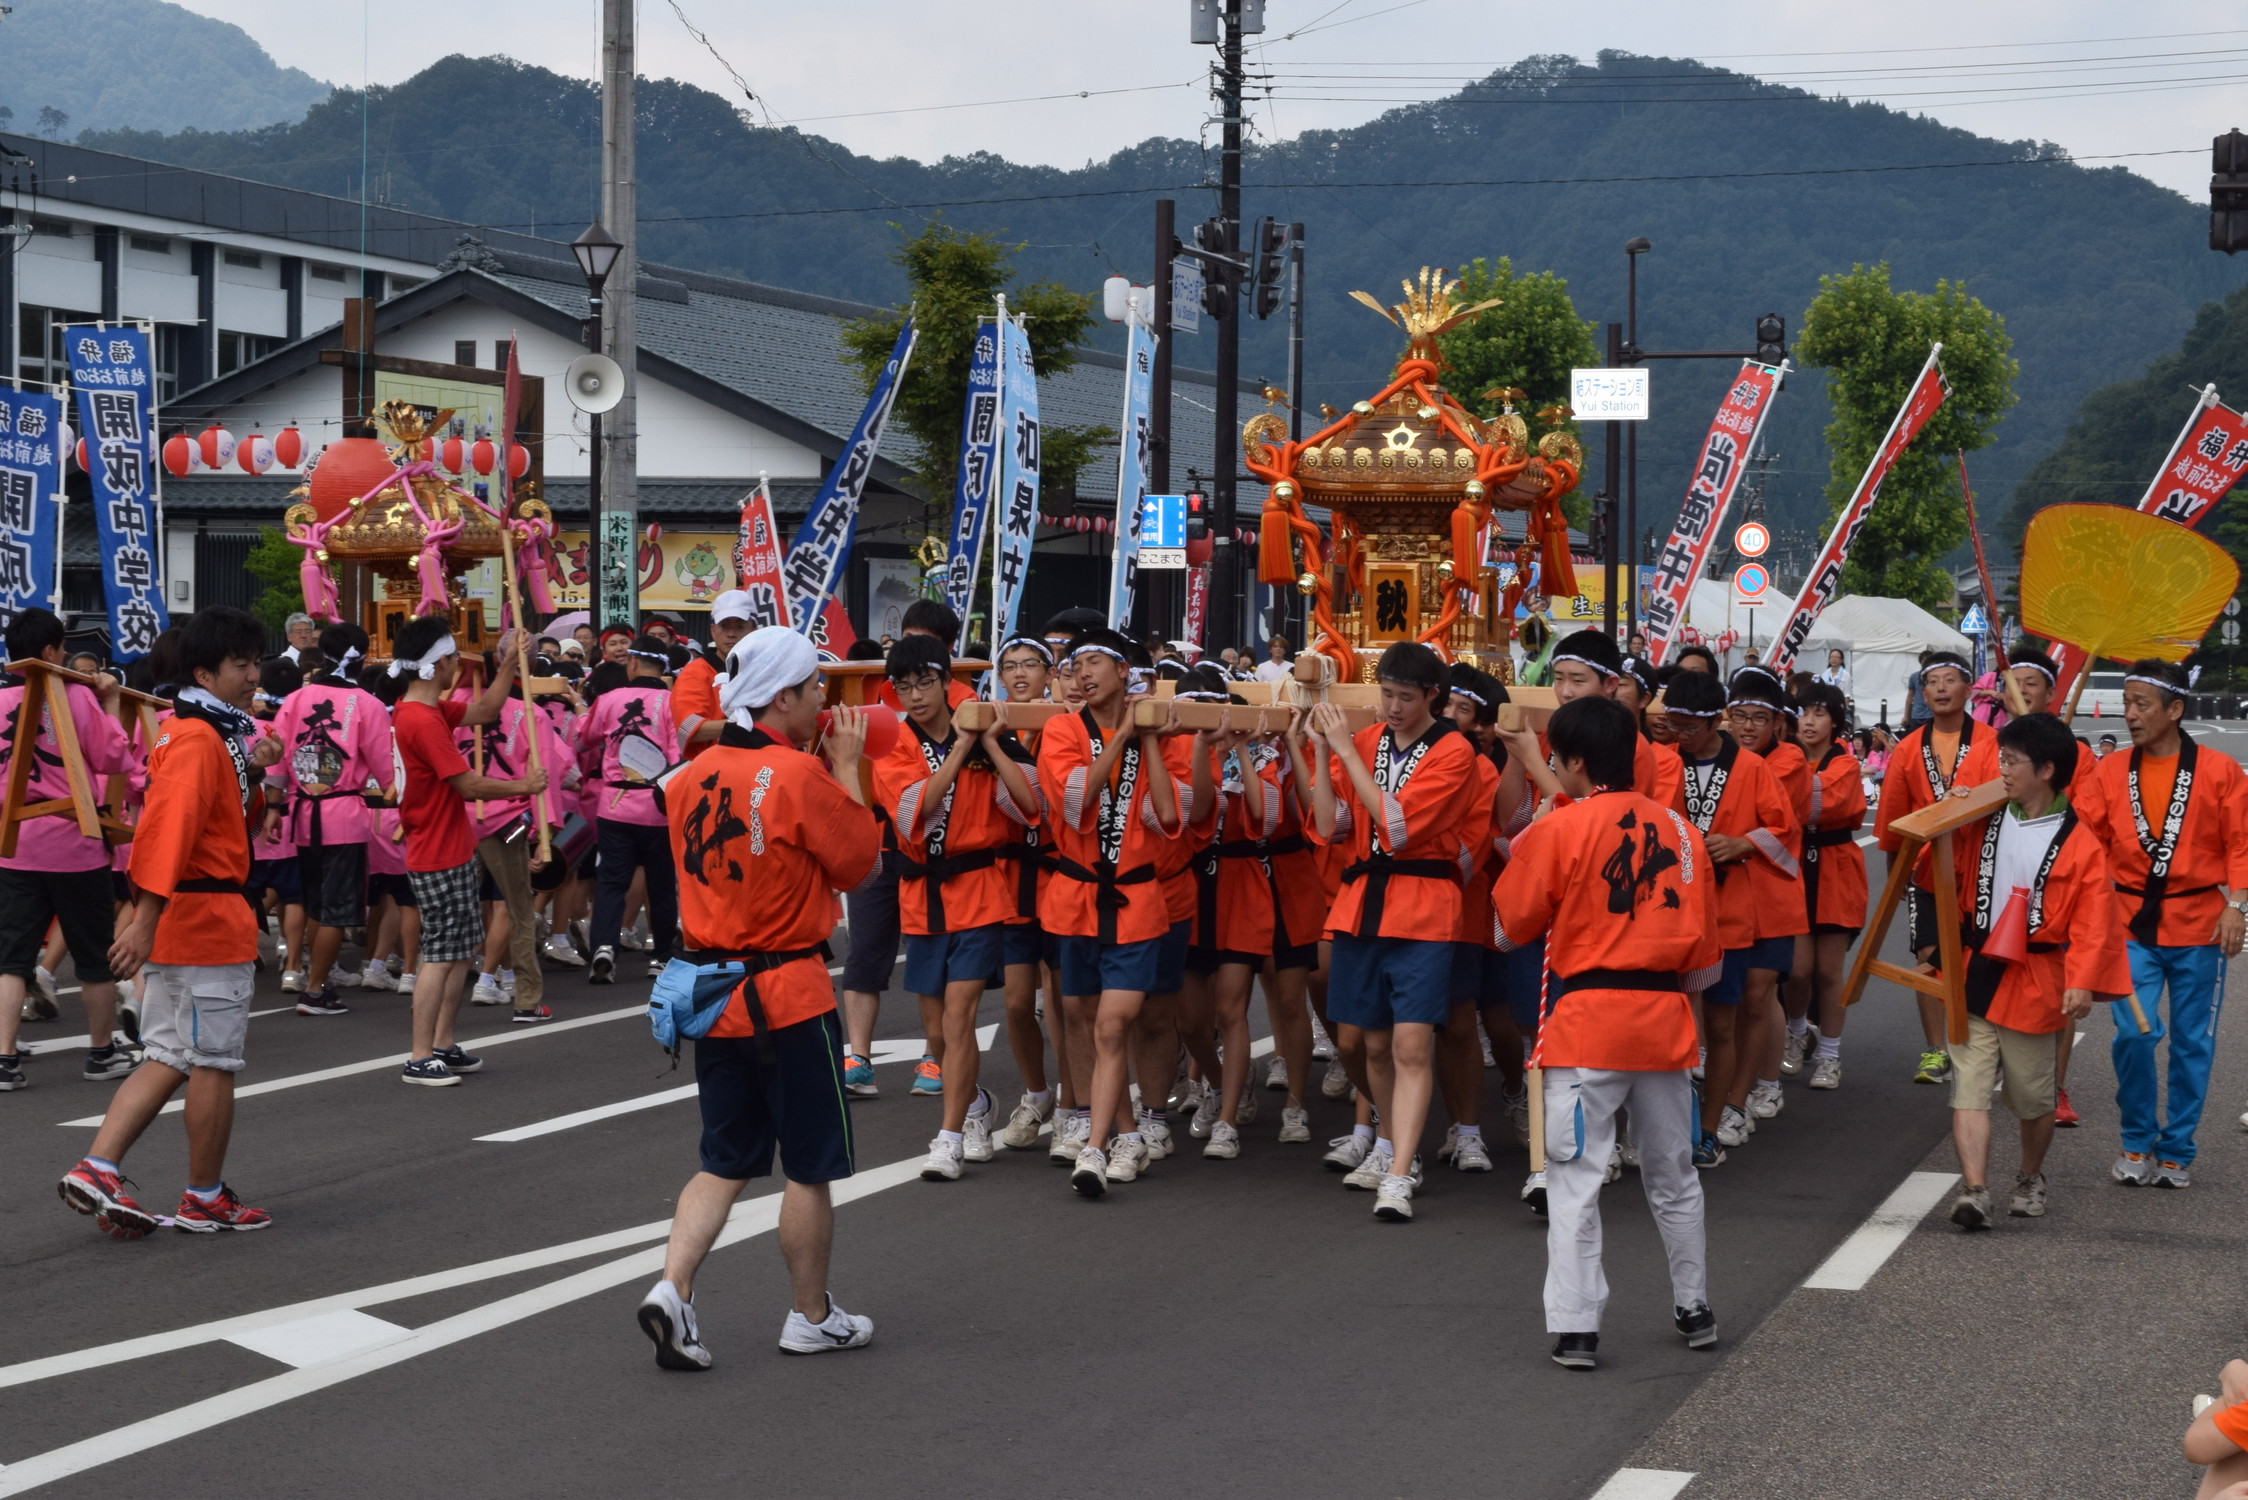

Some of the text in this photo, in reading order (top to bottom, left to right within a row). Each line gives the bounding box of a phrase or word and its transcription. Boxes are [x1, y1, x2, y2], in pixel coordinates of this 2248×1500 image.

[1576, 379, 1645, 397] 結ステーション前
[1580, 400, 1640, 411] Yui Station
[1141, 532, 1158, 542] 専用
[1743, 533, 1762, 547] 40
[1139, 554, 1182, 564] ここまで
[750, 766, 774, 856] 越前おおの
[1107, 747, 1139, 864] おおの城まつり
[2153, 769, 2192, 877] おおの城まつり
